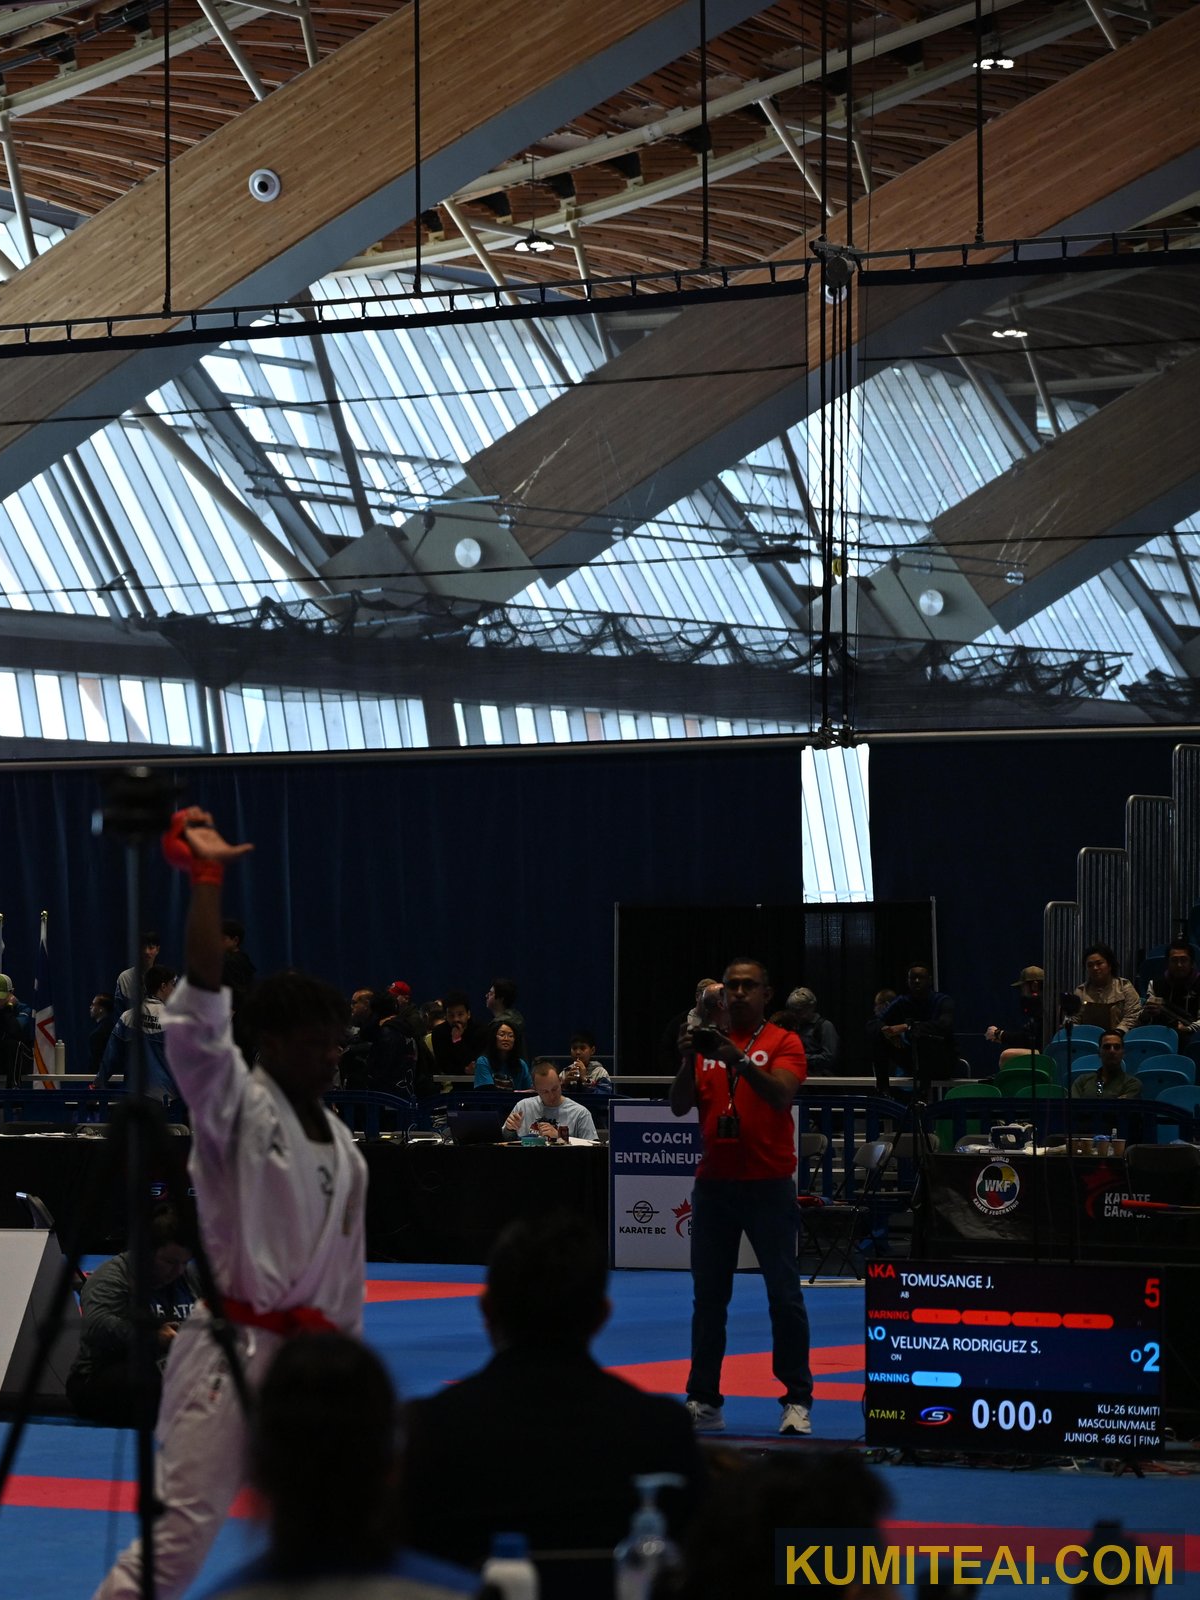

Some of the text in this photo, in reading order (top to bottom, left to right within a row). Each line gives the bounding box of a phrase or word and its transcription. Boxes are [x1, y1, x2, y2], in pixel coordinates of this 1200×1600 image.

[642, 1132, 692, 1145] COACH
[985, 1180, 1010, 1192] WKF
[619, 1226, 652, 1234] KARATE
[900, 1273, 994, 1289] TOMUSANGE J.
[1144, 1278, 1160, 1309] 5
[890, 1335, 1041, 1354] VELUNZA RODRIGUEZ S.
[869, 1410, 905, 1420] ATAMI 2
[1097, 1404, 1160, 1416] KU-26 KUMIT
[1078, 1418, 1156, 1431] MASCULIN/MALE
[1064, 1432, 1098, 1443] JUNIOR
[1101, 1434, 1116, 1444] -68
[1119, 1435, 1131, 1444] KG
